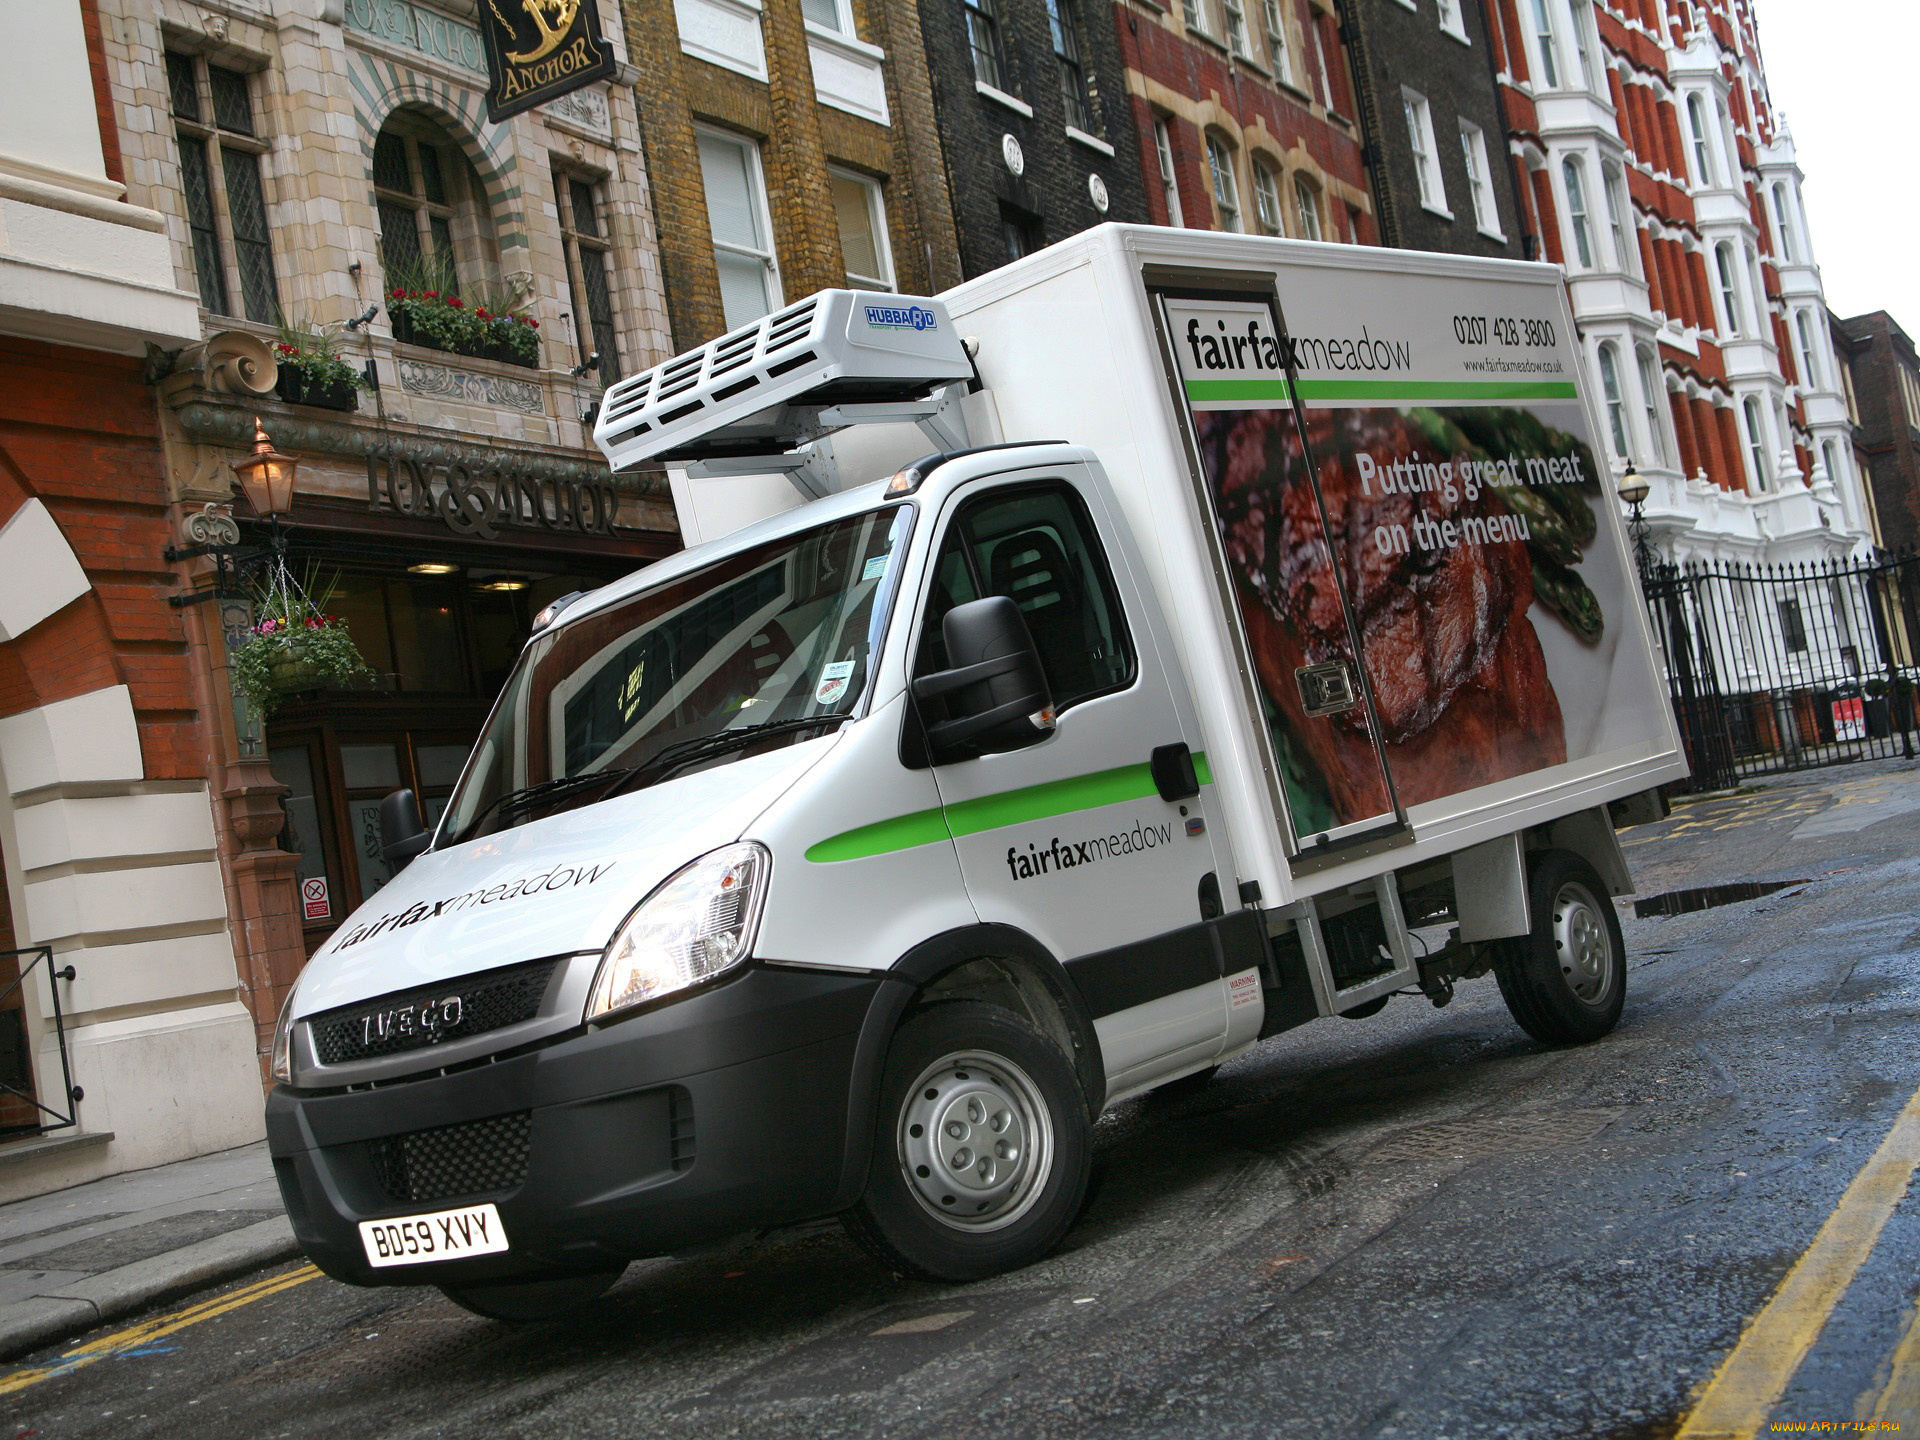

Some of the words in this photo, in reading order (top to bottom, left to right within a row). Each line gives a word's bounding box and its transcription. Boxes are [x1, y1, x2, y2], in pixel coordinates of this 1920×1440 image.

[503, 36, 592, 100] ANCHOR
[867, 308, 934, 328] HUBBARD
[1453, 315, 1488, 345] 0207
[1493, 317, 1520, 347] 428
[1520, 318, 1556, 348] 3800
[1186, 318, 1411, 371] fairfaxmeadow
[1463, 357, 1564, 374] www.fairfaxmeadow.co.uk
[438, 461, 500, 541] &
[1355, 450, 1459, 503] Putting
[1459, 451, 1523, 502] great
[1524, 449, 1585, 486] meat
[1374, 523, 1411, 556] on
[1412, 508, 1459, 552] the
[1461, 512, 1531, 547] menu
[1006, 819, 1172, 881] fairfaxmeadow
[330, 860, 617, 955] fairfaxmeadow
[1230, 975, 1256, 989] WARNING
[361, 996, 462, 1046] IVECO
[371, 1220, 435, 1258] BD59
[436, 1211, 489, 1251] XVY
